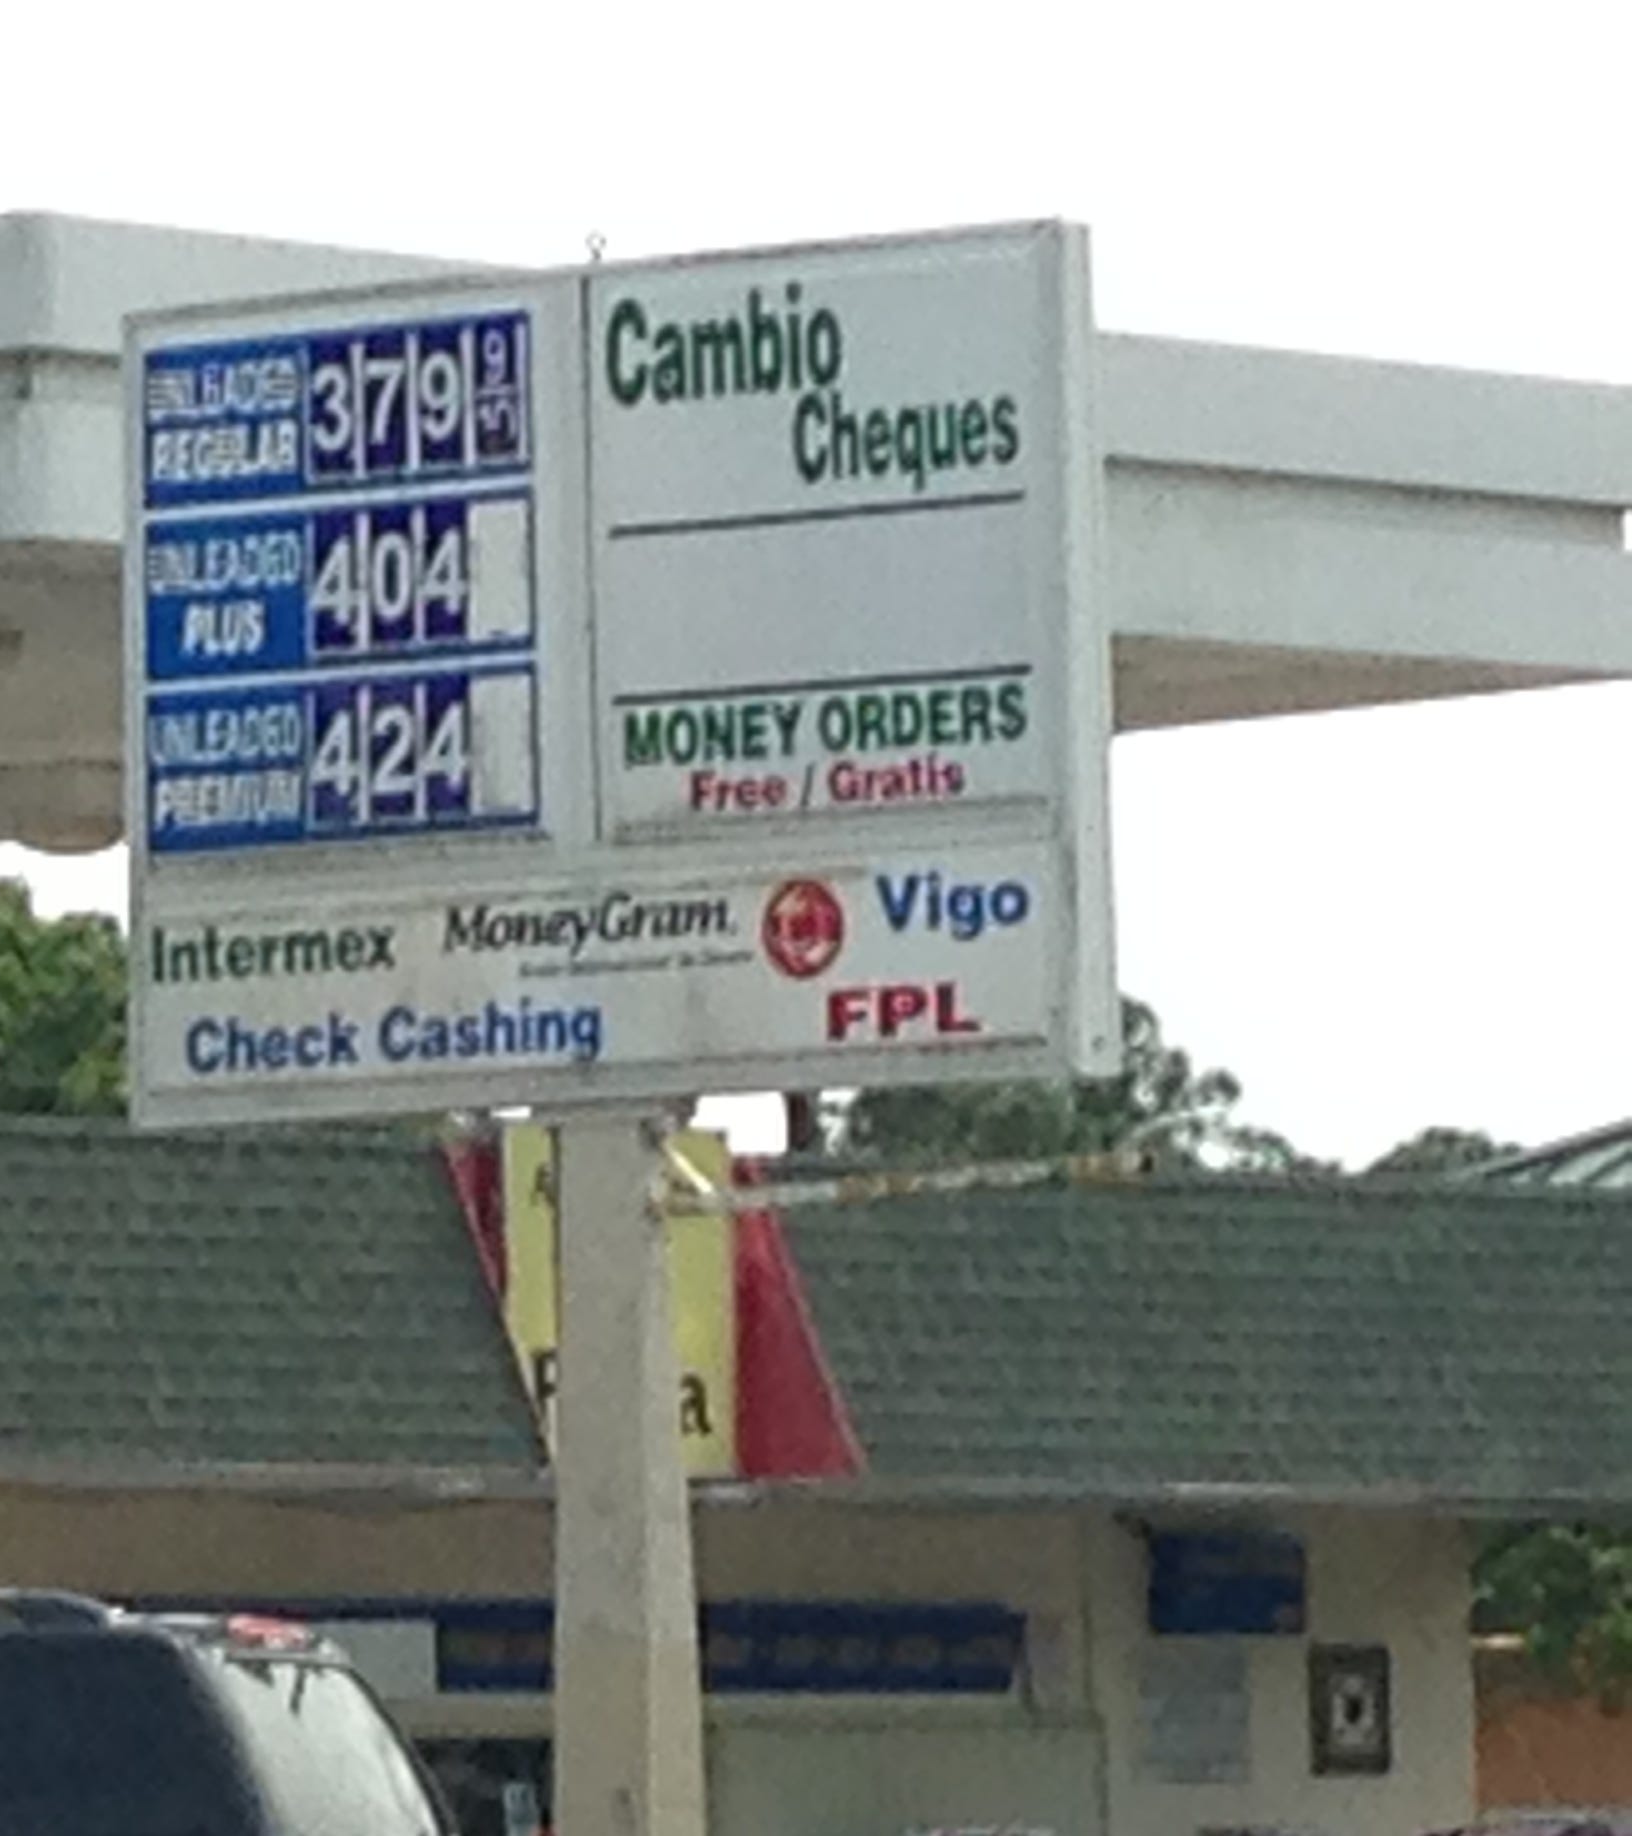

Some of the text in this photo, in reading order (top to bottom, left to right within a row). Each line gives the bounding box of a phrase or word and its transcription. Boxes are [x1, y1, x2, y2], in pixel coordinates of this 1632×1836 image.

[605, 280, 843, 406] Cambio
[152, 419, 297, 480] REGULAR
[792, 390, 1019, 493] Cheques
[148, 531, 301, 595] UNLEADED
[181, 601, 265, 655] PLUS
[149, 704, 301, 763] UNLEADED
[624, 683, 1028, 769] MONEY ORDERS
[154, 771, 301, 828] PREMIUM
[689, 769, 788, 811] Free
[828, 752, 966, 804] Gratis
[875, 870, 1031, 941] Vigo
[152, 924, 397, 983] Intermex
[185, 997, 603, 1075] Check Cashing
[826, 982, 983, 1042] FPL
